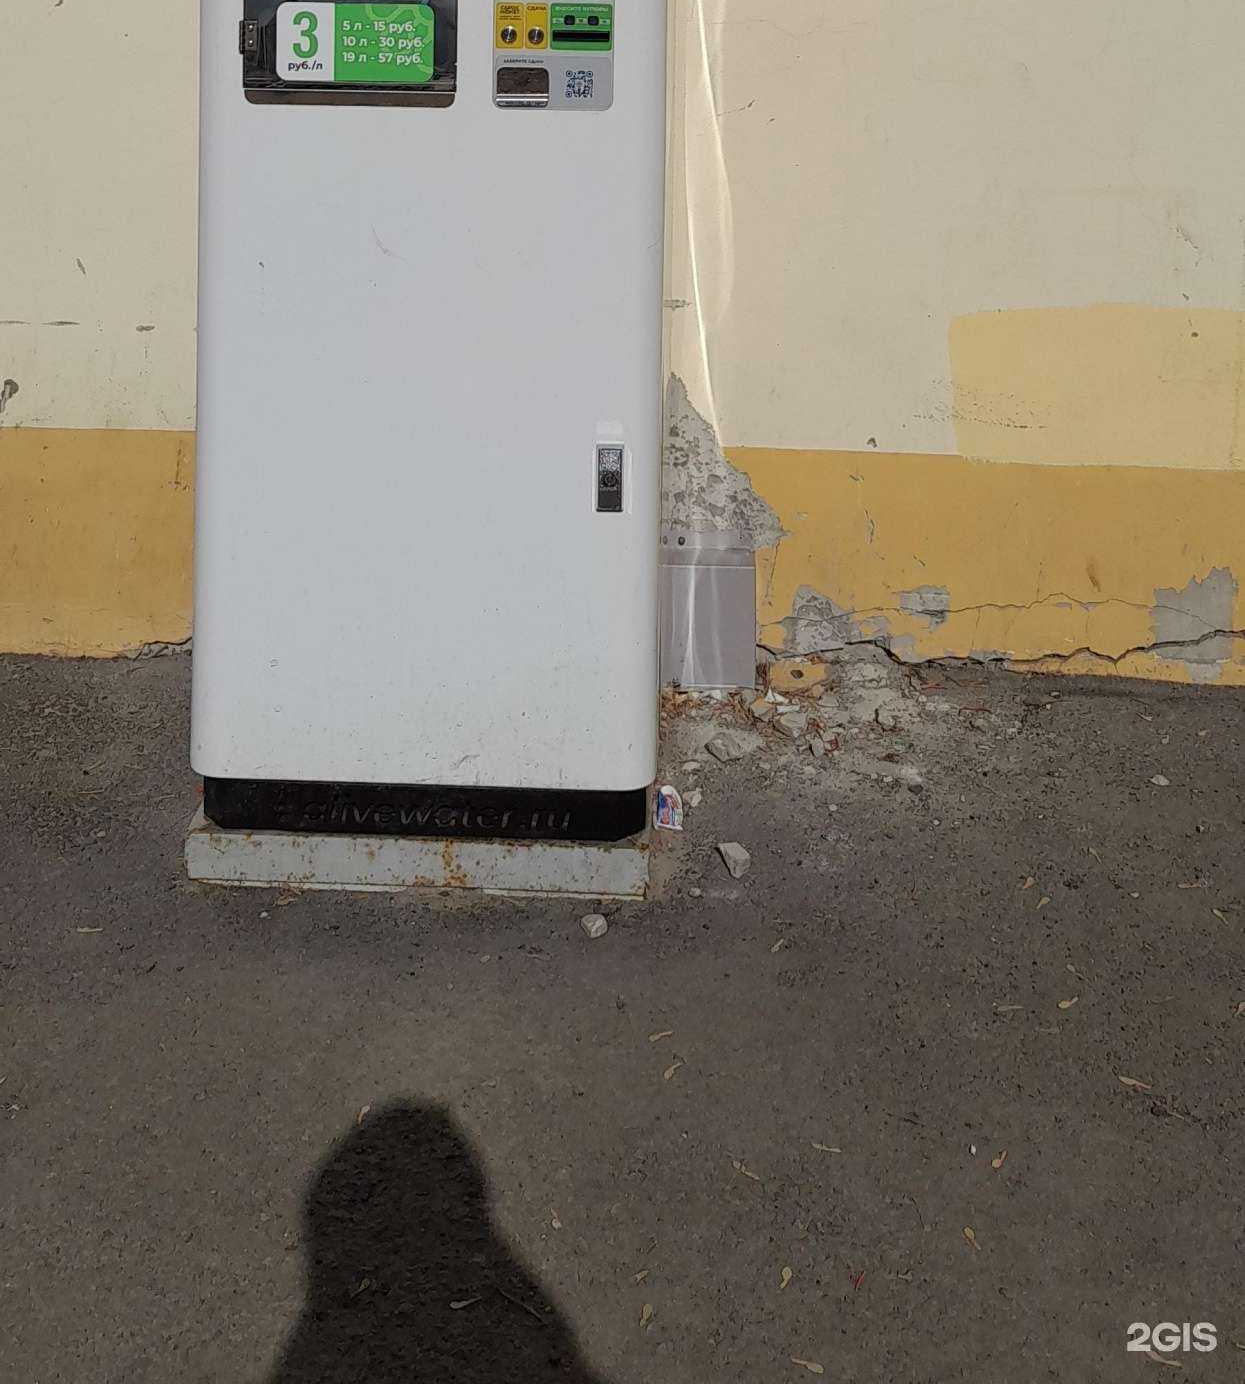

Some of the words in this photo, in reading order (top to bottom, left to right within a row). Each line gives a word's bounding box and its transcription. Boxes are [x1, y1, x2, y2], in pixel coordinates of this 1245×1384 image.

[342, 20, 351, 31] 5
[353, 22, 362, 31] л
[373, 21, 386, 31] 15
[389, 21, 416, 34] руб.
[292, 11, 319, 59] 3
[342, 36, 356, 47] 10
[358, 38, 368, 47] л
[378, 37, 395, 47] 30
[398, 37, 425, 50] руб.
[288, 60, 323, 72] руб./л
[342, 52, 356, 62] 19
[358, 54, 367, 63] л
[378, 53, 393, 63] 57
[396, 54, 424, 66] руб.
